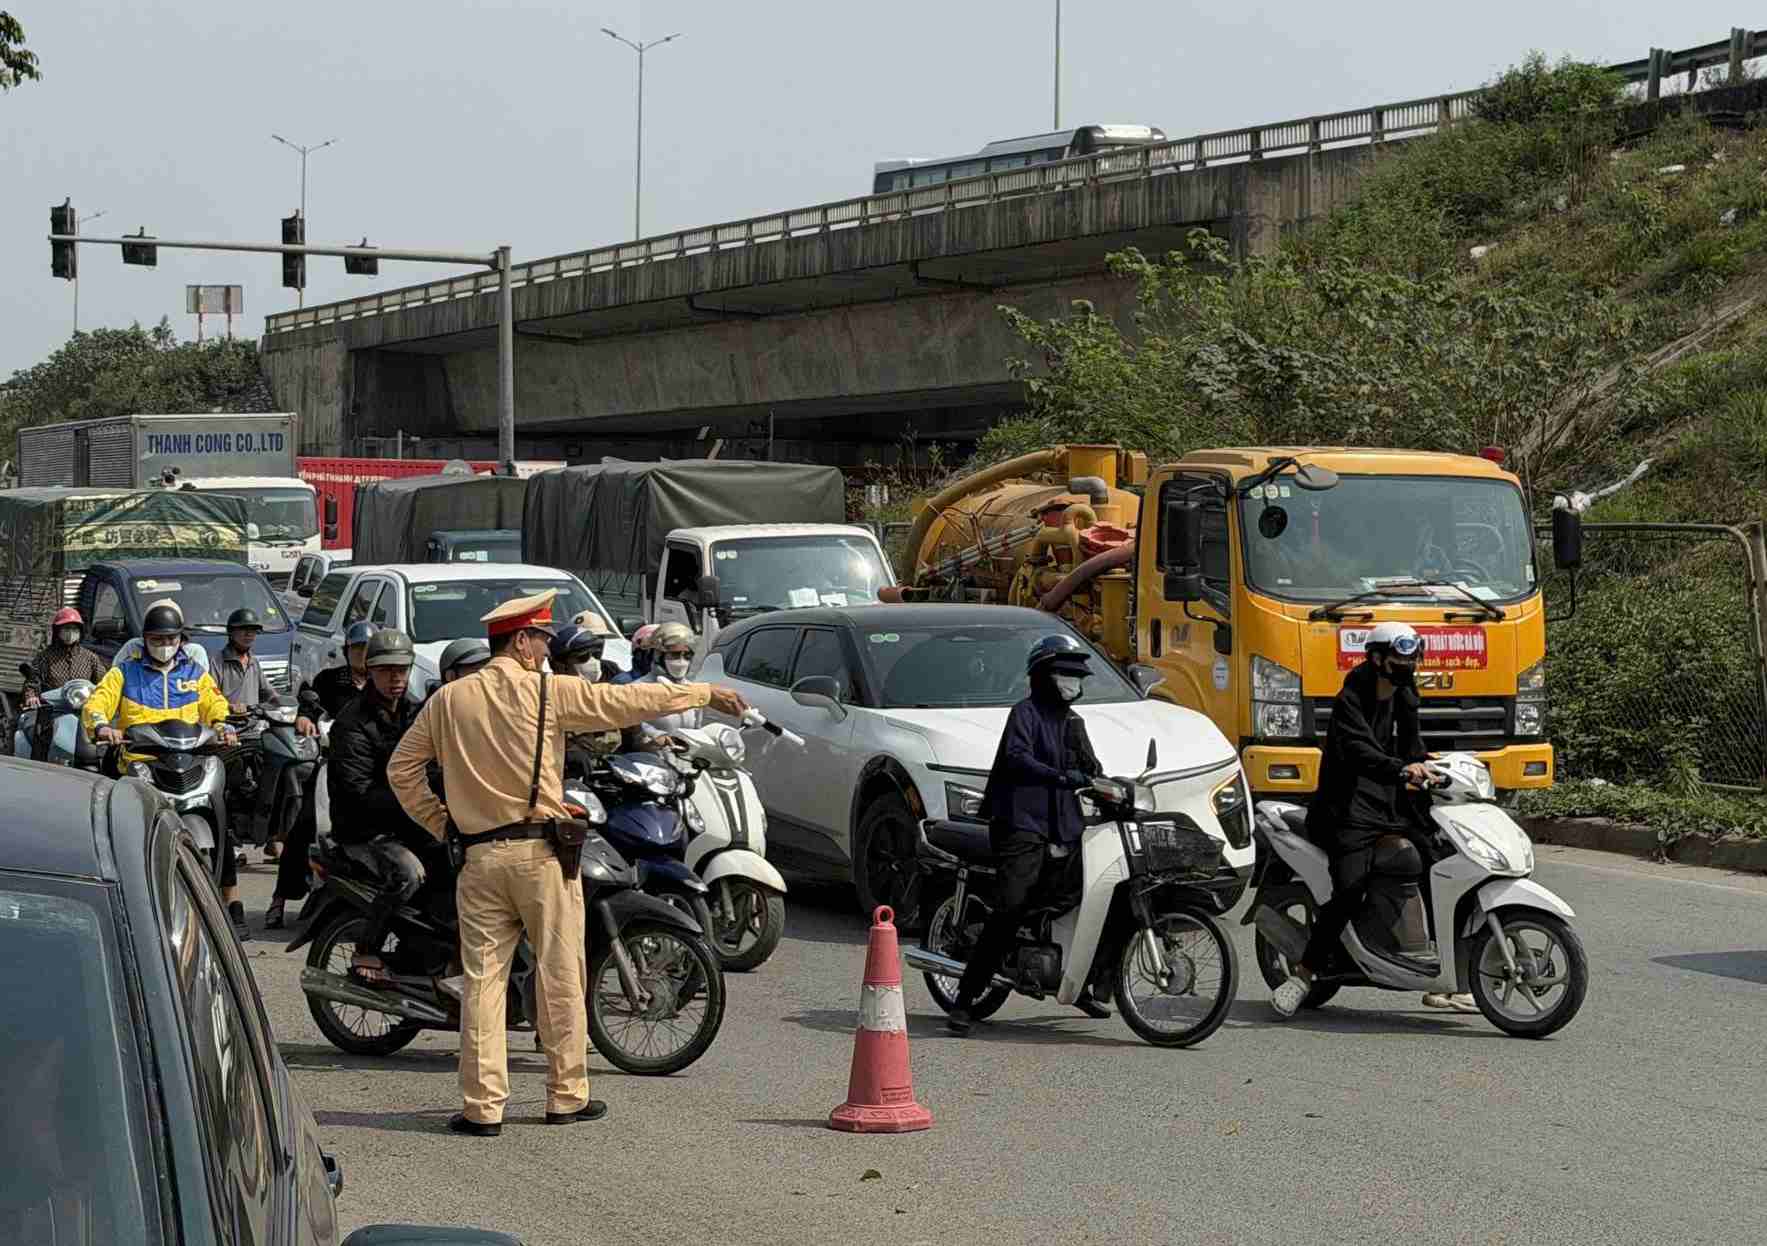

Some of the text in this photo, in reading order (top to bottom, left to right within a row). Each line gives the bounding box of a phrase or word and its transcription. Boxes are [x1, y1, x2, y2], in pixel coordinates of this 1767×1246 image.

[147, 432, 284, 455] THANH CONG CO.,LTD
[176, 678, 198, 692] be
